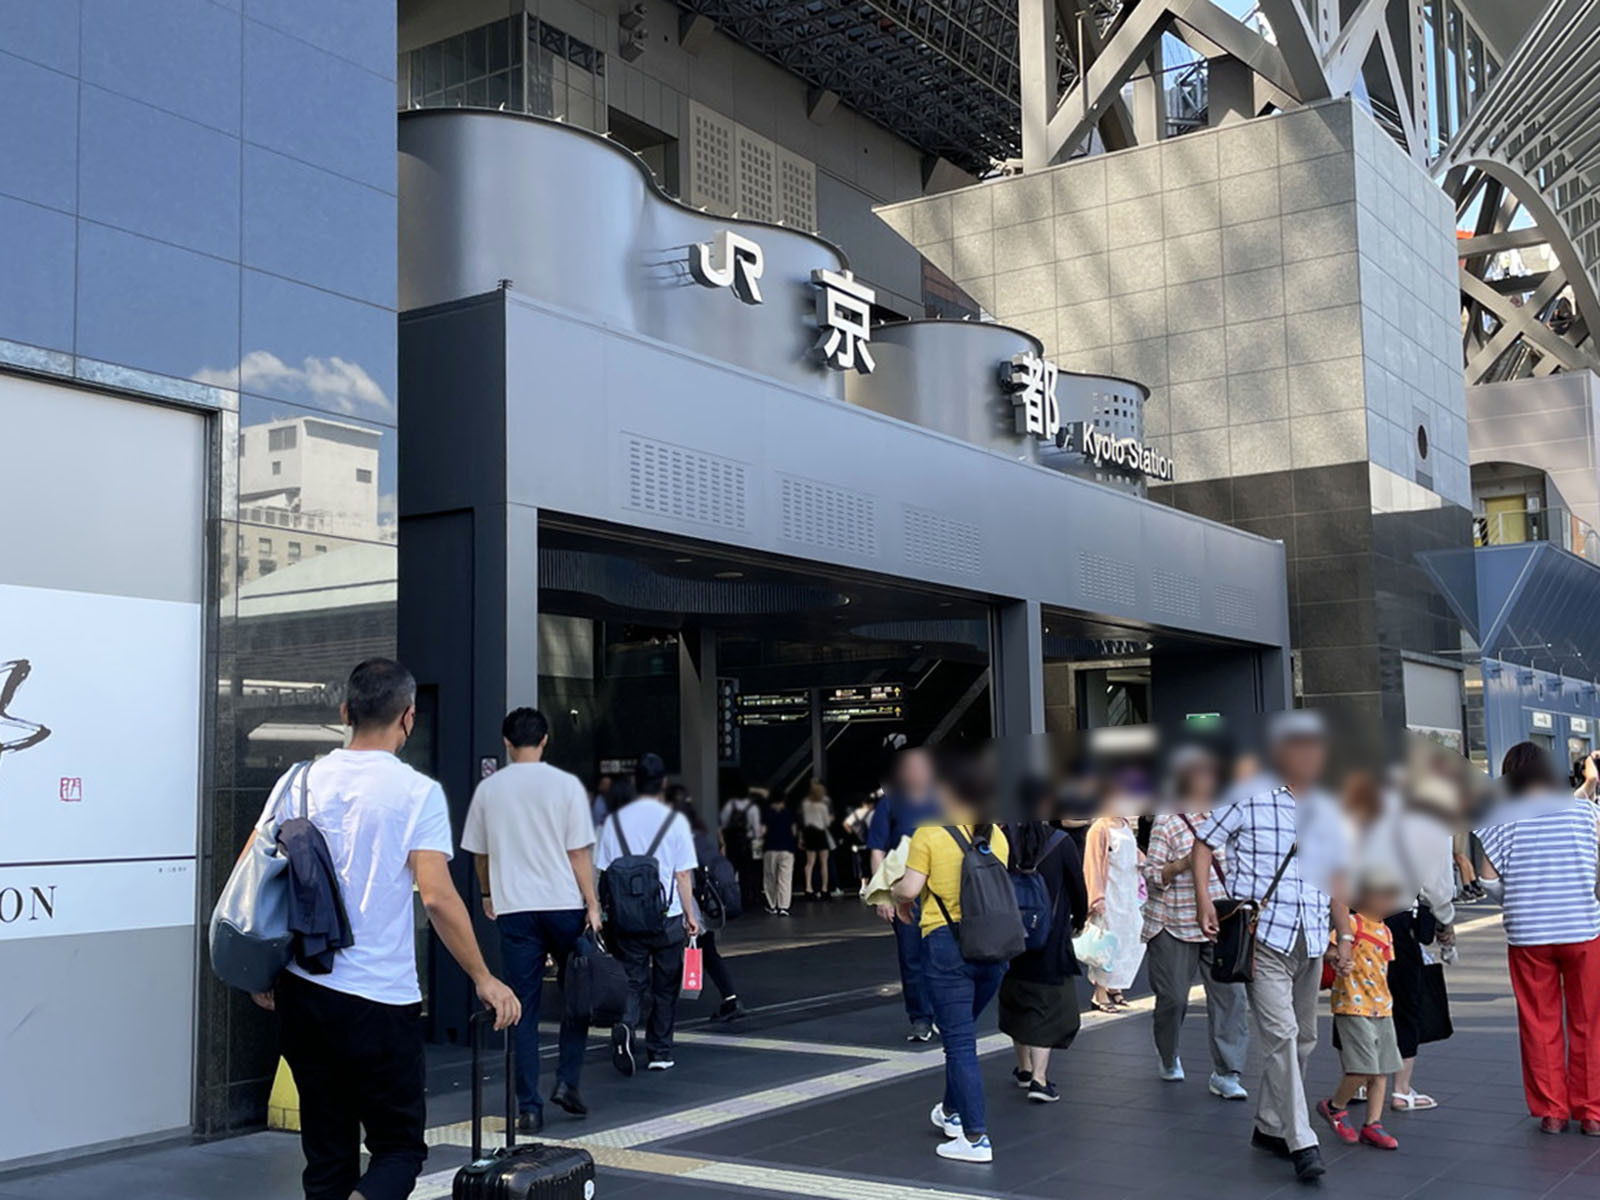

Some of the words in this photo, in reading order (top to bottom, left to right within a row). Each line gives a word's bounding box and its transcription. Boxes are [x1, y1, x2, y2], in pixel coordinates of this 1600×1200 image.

[690, 229, 765, 305] JR
[1082, 421, 1125, 464] Kyoto
[1128, 439, 1175, 480] Station
